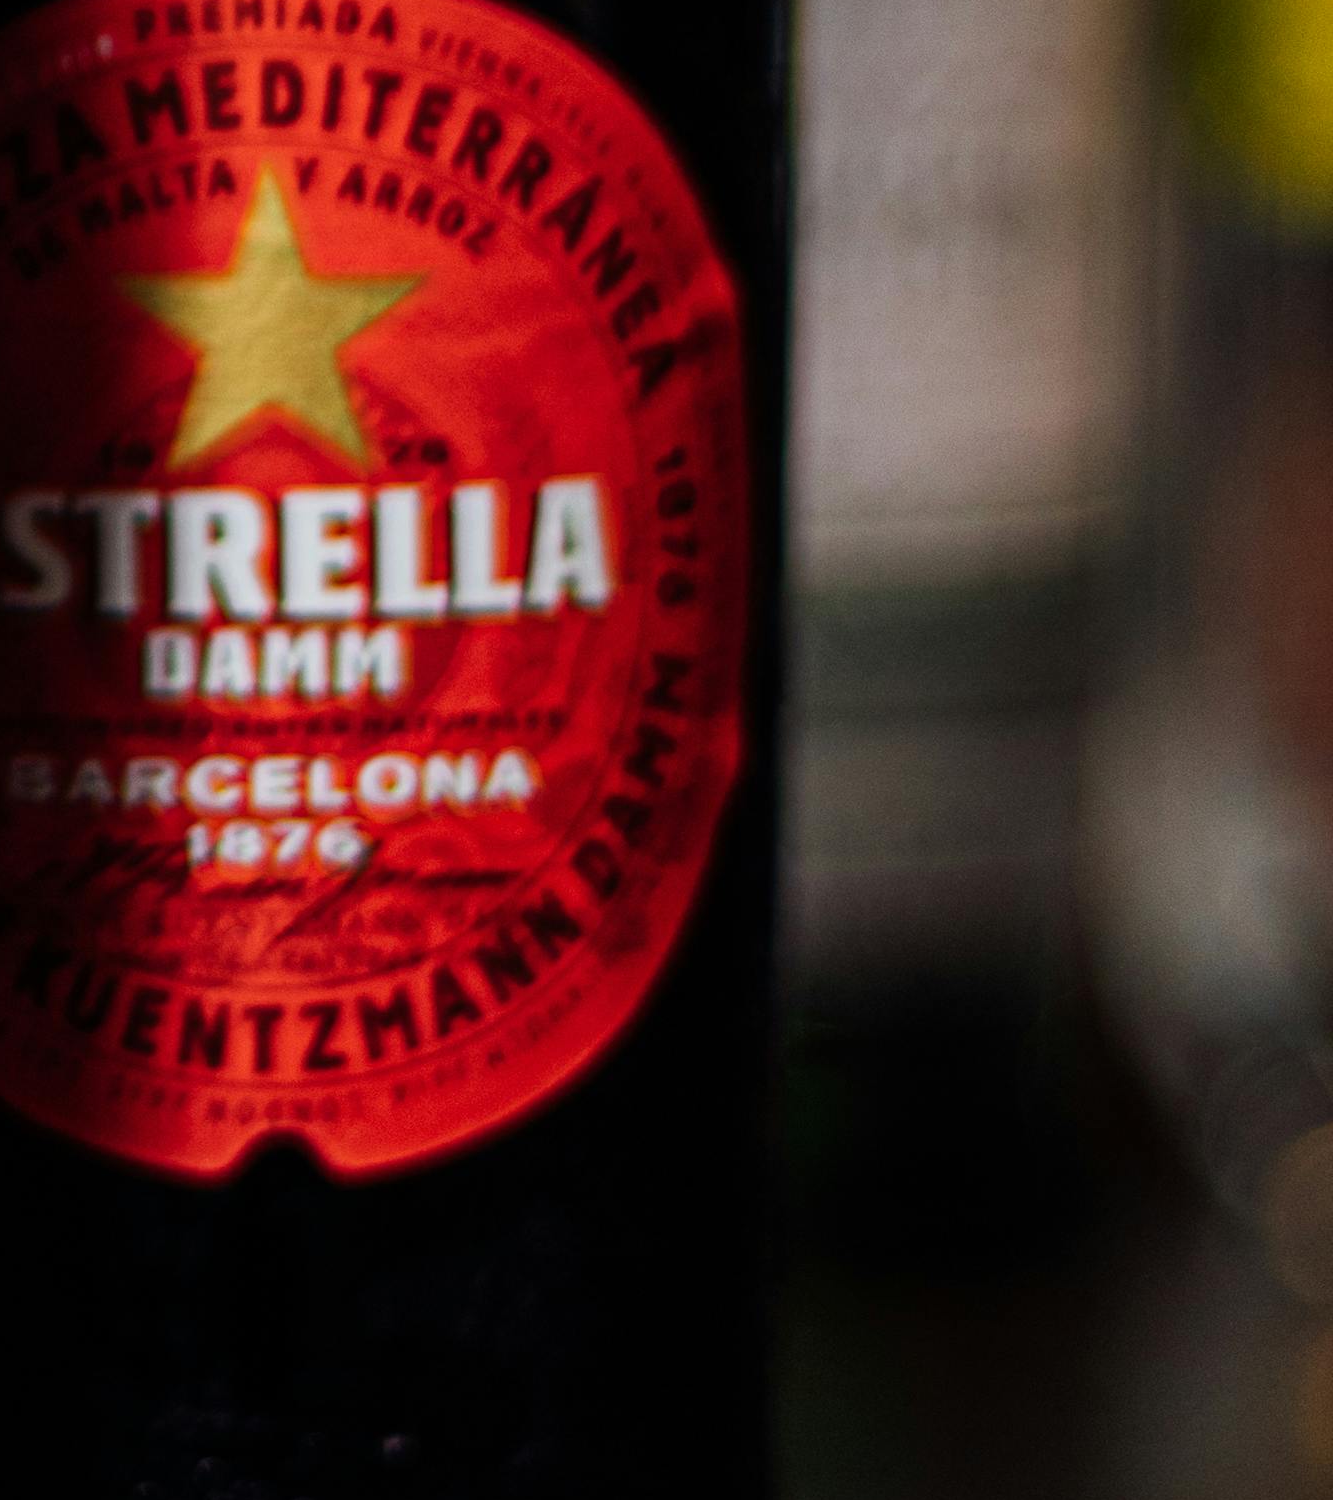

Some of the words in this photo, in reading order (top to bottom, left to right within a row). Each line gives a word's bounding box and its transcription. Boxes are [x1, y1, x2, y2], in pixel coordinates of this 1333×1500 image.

[140, 626, 408, 699] DAMM
[6, 747, 537, 810] BARCELONA
[183, 818, 373, 875] 1876
